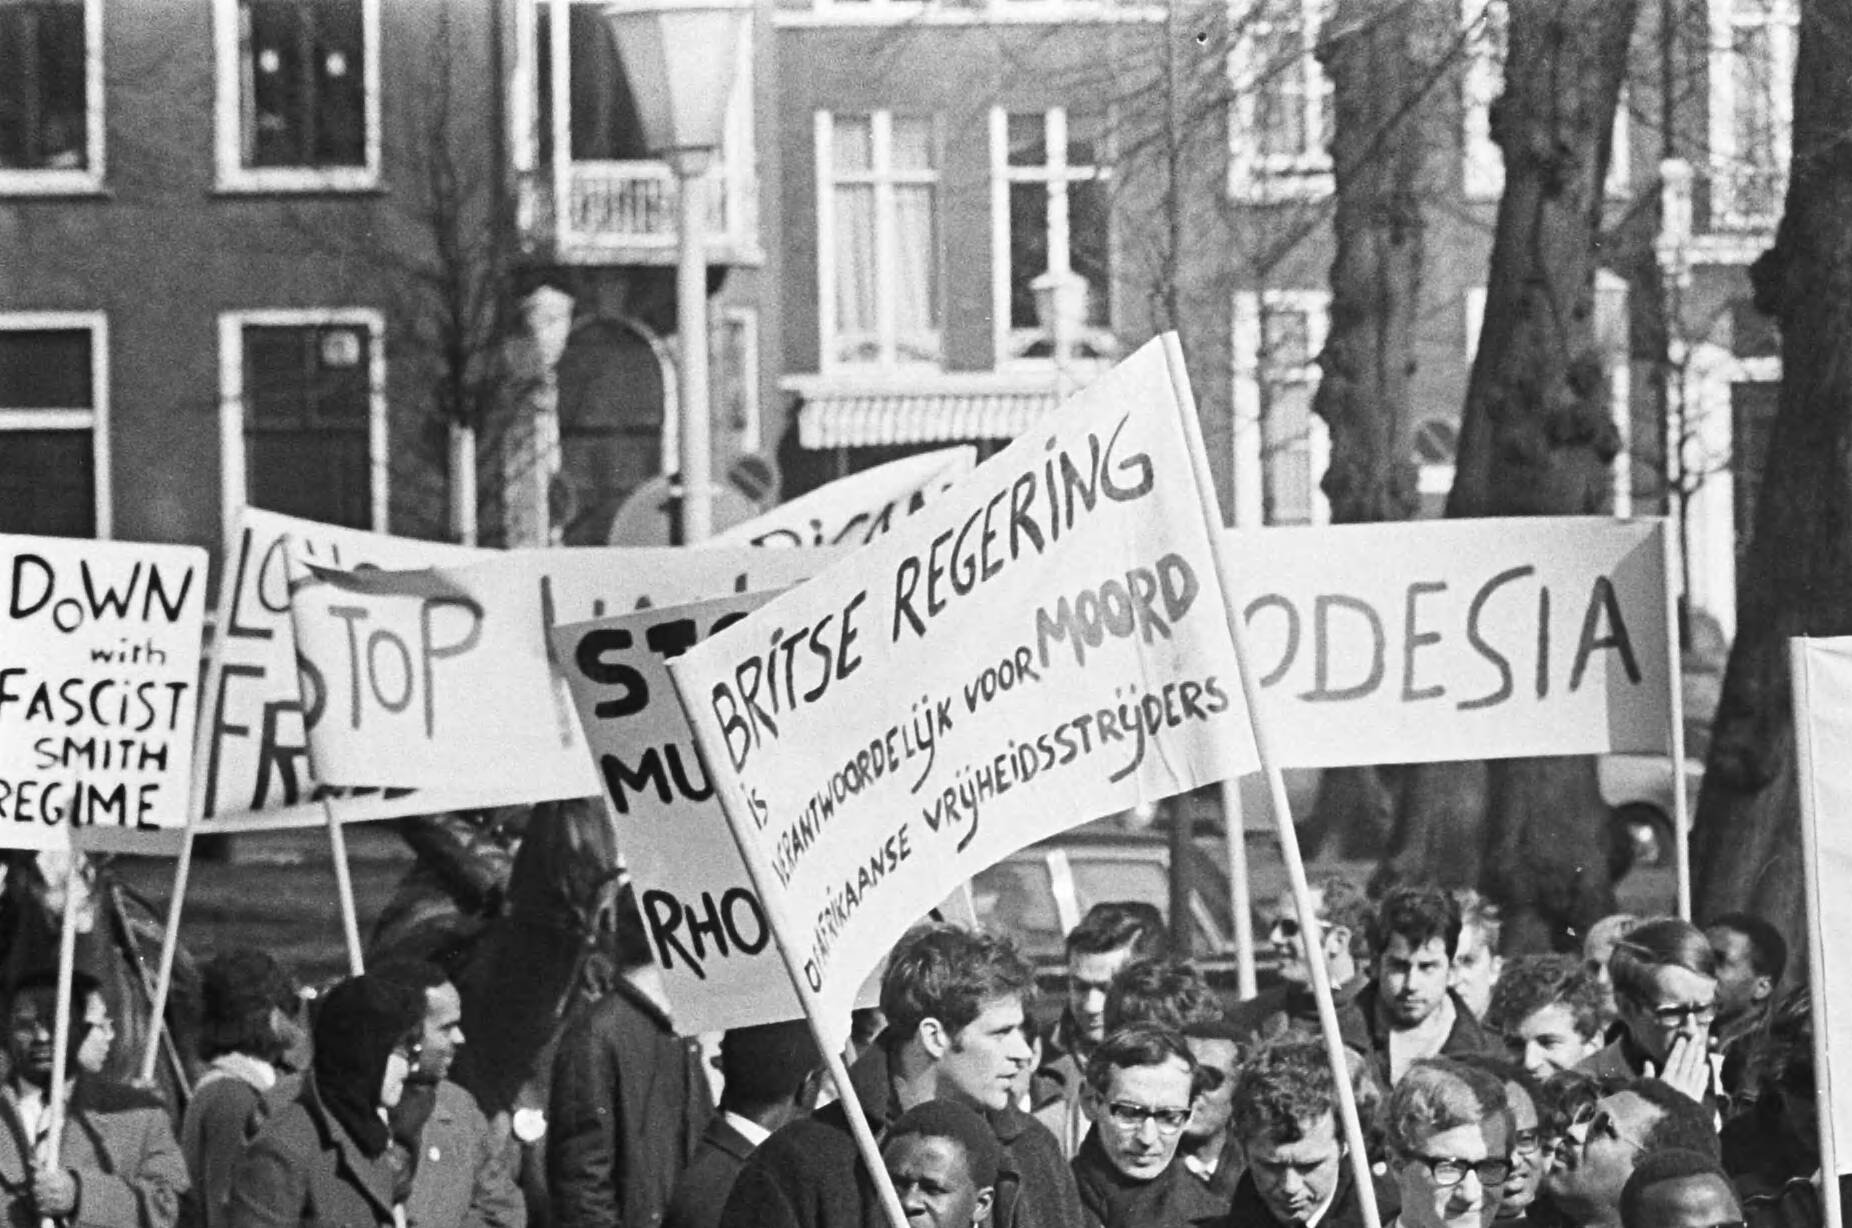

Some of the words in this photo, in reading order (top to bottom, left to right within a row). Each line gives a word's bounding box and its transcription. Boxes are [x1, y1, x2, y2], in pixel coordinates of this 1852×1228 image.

[963, 646, 1041, 714] VOOR
[1035, 552, 1201, 668] MOORD
[33, 736, 169, 773] SMITH
